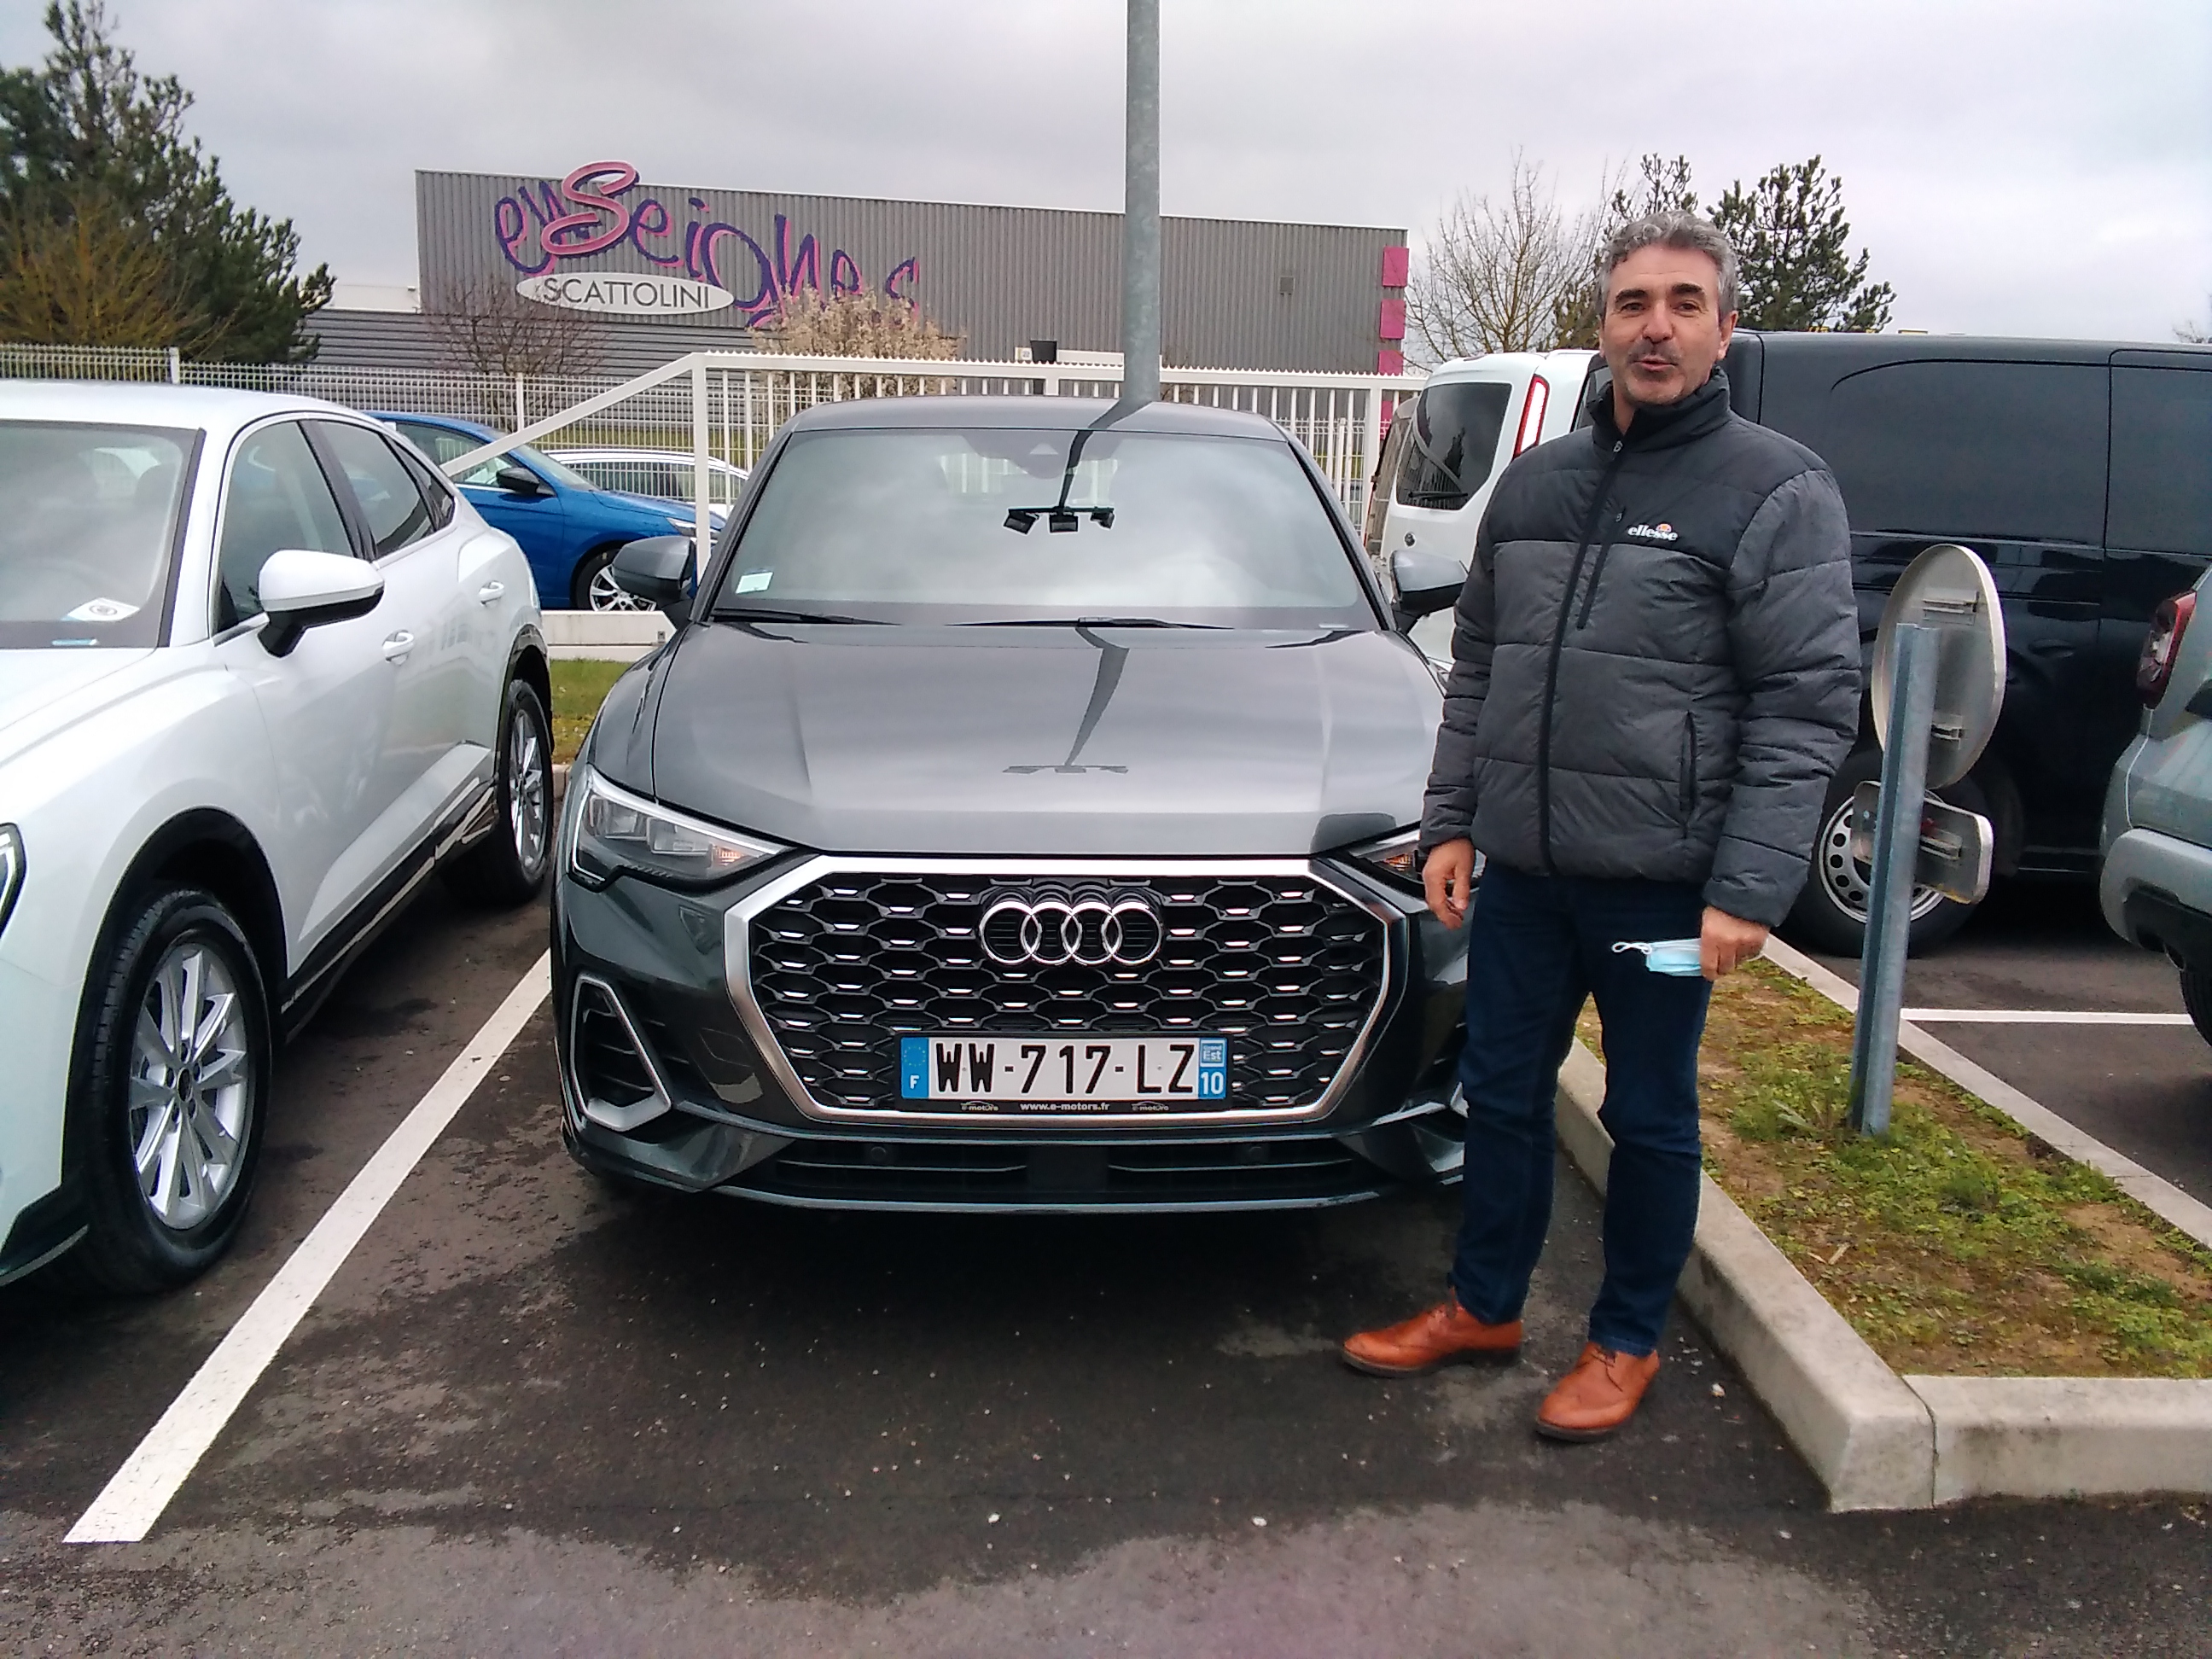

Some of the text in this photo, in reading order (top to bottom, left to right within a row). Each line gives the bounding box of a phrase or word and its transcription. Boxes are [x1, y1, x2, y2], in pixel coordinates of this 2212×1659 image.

[543, 276, 709, 310] SCATTOLINI
[1627, 524, 1679, 541] ellesse
[1202, 1050, 1222, 1061] Est
[909, 1074, 920, 1090] F
[1200, 1071, 1224, 1095] 10
[1020, 1102, 1110, 1111] www.e-motors.fr
